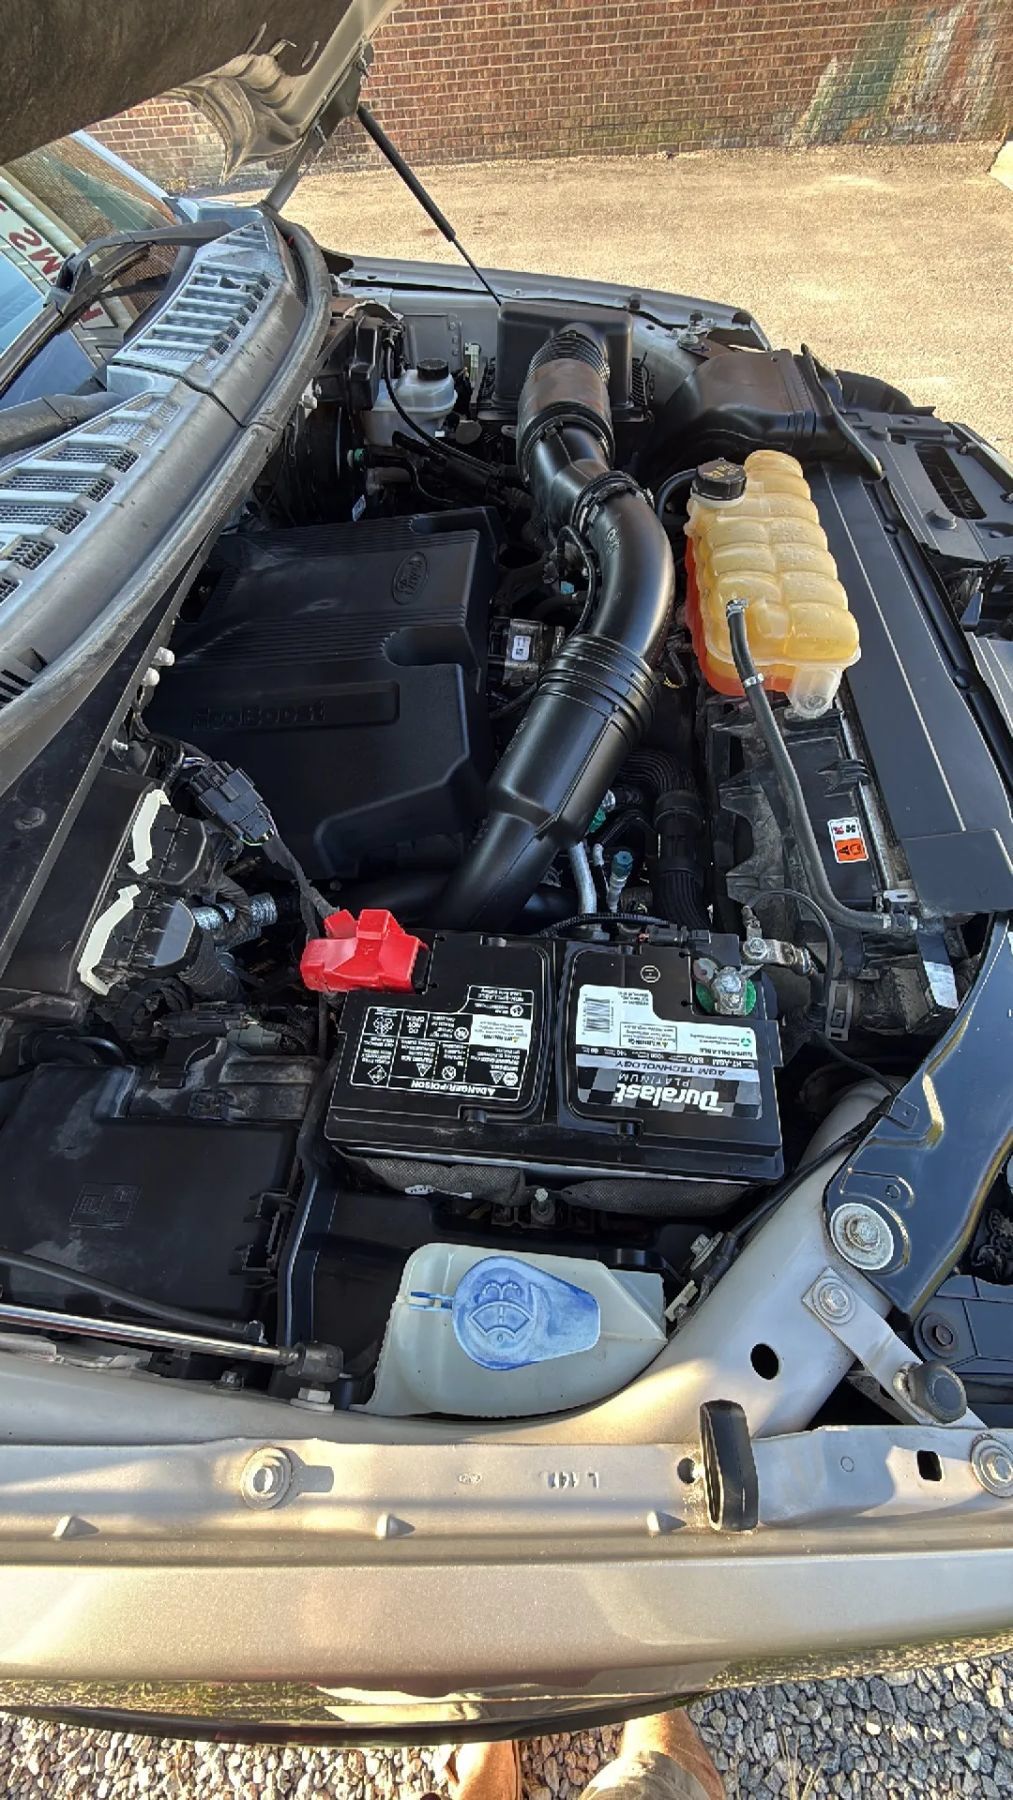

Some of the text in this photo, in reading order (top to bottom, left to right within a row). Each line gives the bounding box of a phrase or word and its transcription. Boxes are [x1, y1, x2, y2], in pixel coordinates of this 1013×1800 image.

[615, 1060, 727, 1076] AGM TECHNOLOGY
[618, 1073, 690, 1088] PLATINUM
[614, 1083, 724, 1113] Duralast
